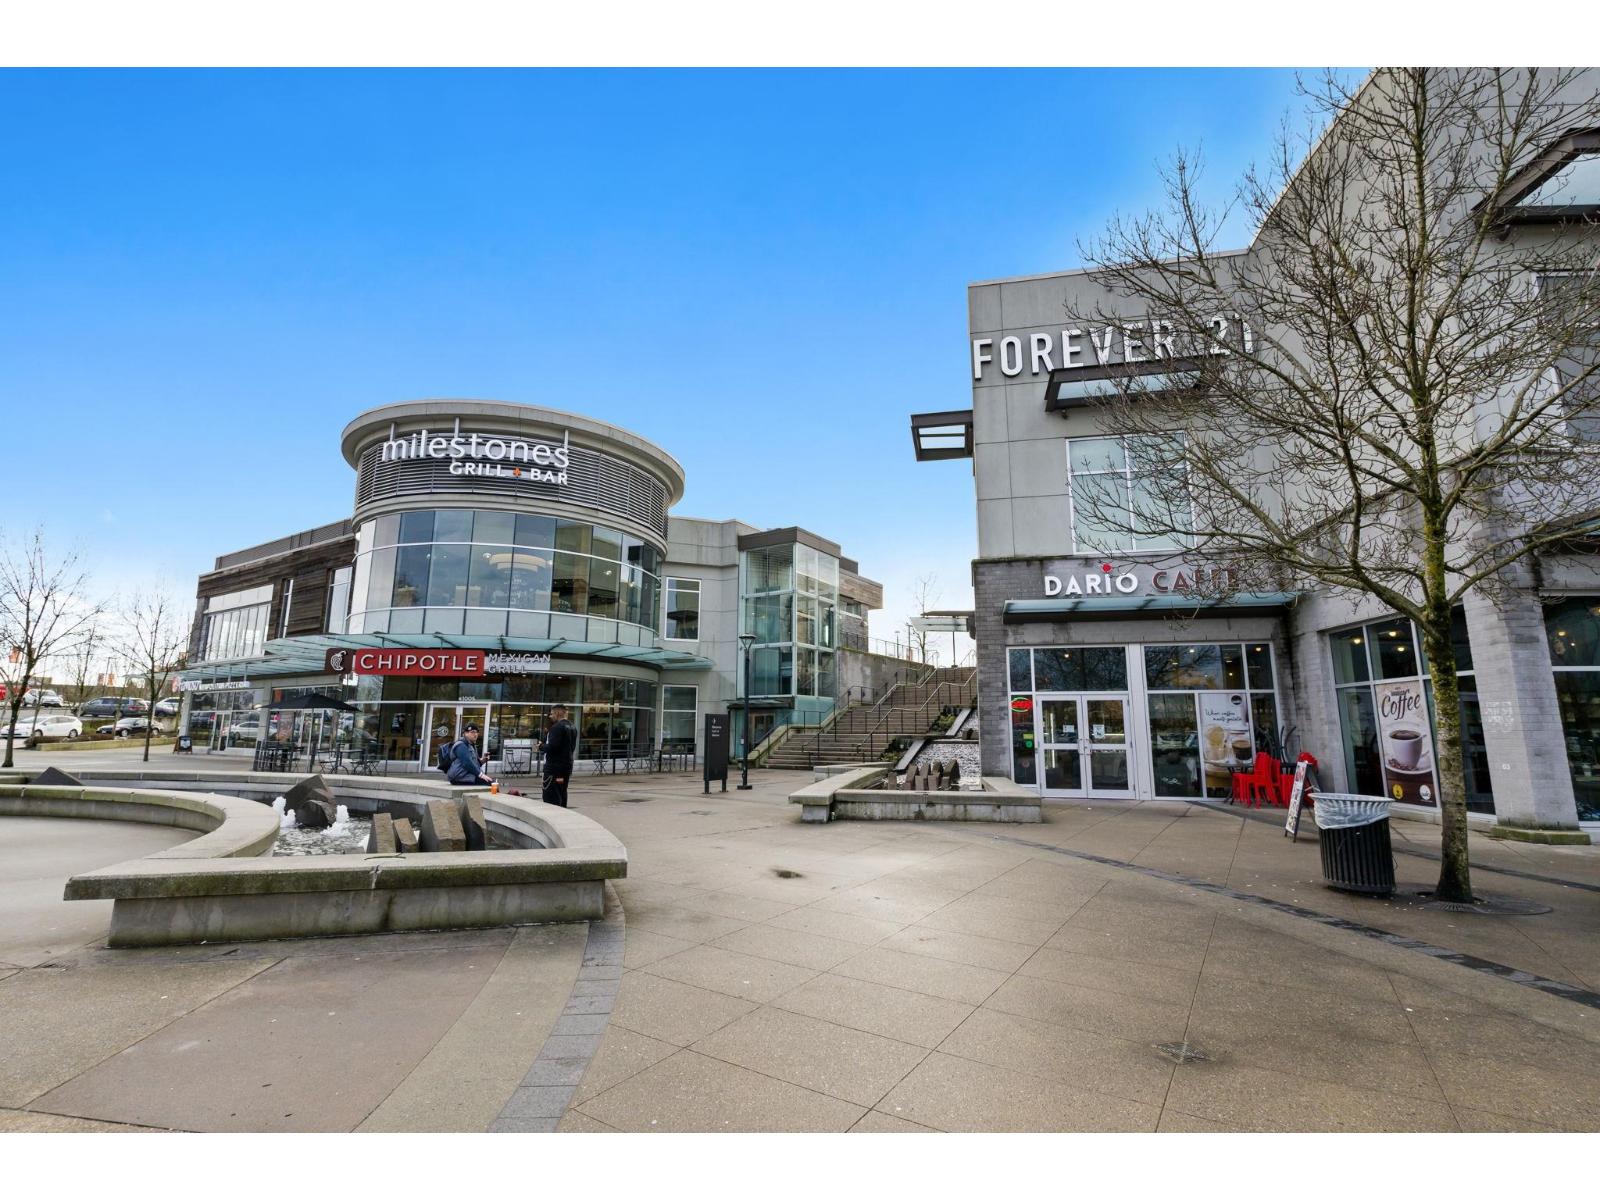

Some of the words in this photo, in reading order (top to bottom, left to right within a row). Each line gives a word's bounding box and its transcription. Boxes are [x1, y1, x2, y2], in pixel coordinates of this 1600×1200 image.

[973, 320, 1178, 380] FOREVER
[1206, 312, 1254, 355] 21
[381, 429, 570, 468] milestones
[449, 462, 507, 478] GRILL
[530, 467, 568, 485] BAR
[1044, 563, 1139, 596] DARIO
[360, 654, 478, 671] CHIPOTLE
[488, 653, 551, 664] MEXICAN
[488, 665, 528, 674] GRILL
[1381, 688, 1421, 721] Coffee
